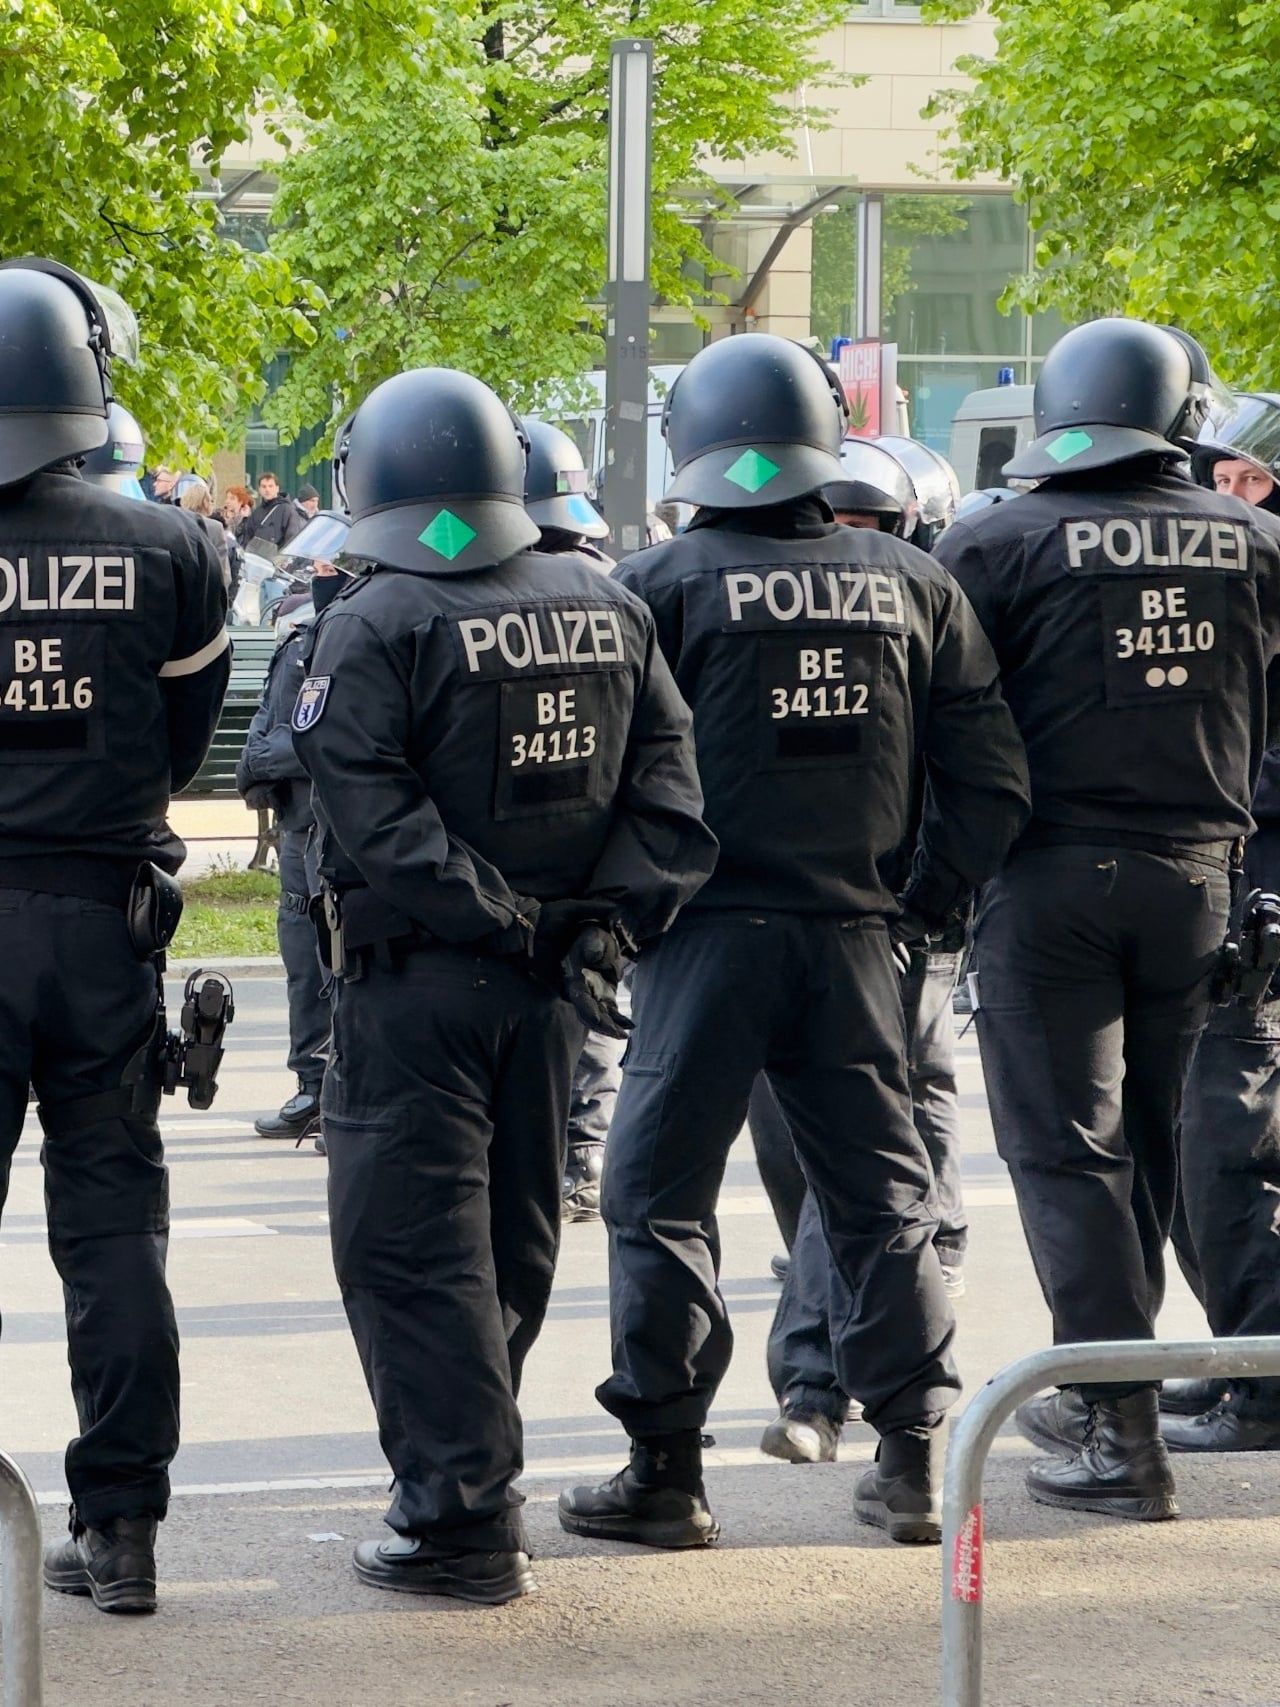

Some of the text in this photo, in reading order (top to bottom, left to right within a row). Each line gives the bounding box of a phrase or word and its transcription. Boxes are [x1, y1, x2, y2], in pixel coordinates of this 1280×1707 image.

[841, 346, 878, 382] HIGH!
[1066, 519, 1247, 570] POLIZEI
[725, 570, 907, 622] POLIZEI
[1142, 587, 1187, 619] BE
[15, 639, 62, 672] BE
[458, 609, 625, 672] POLIZEI
[1116, 621, 1214, 658] 34110
[801, 648, 844, 680] BE
[538, 689, 575, 725] BE
[772, 685, 868, 718] 34112
[512, 726, 595, 766] 34113
